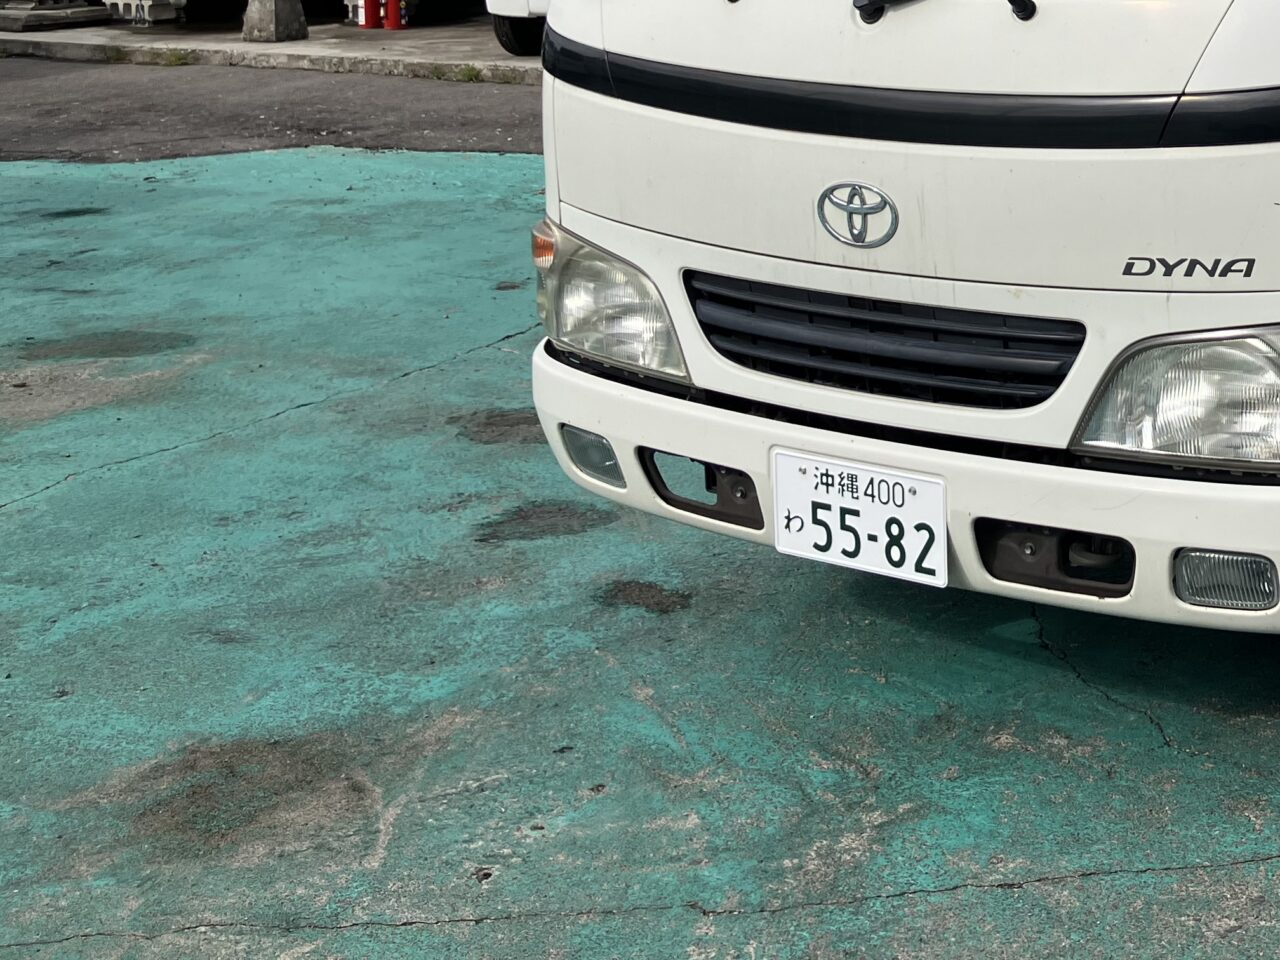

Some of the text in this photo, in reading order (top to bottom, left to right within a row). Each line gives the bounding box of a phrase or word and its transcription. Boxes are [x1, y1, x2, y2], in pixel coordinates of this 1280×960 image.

[1122, 257, 1256, 277] DYNA
[813, 466, 905, 508] 沖縄 400
[784, 500, 937, 577] わ 55-82
